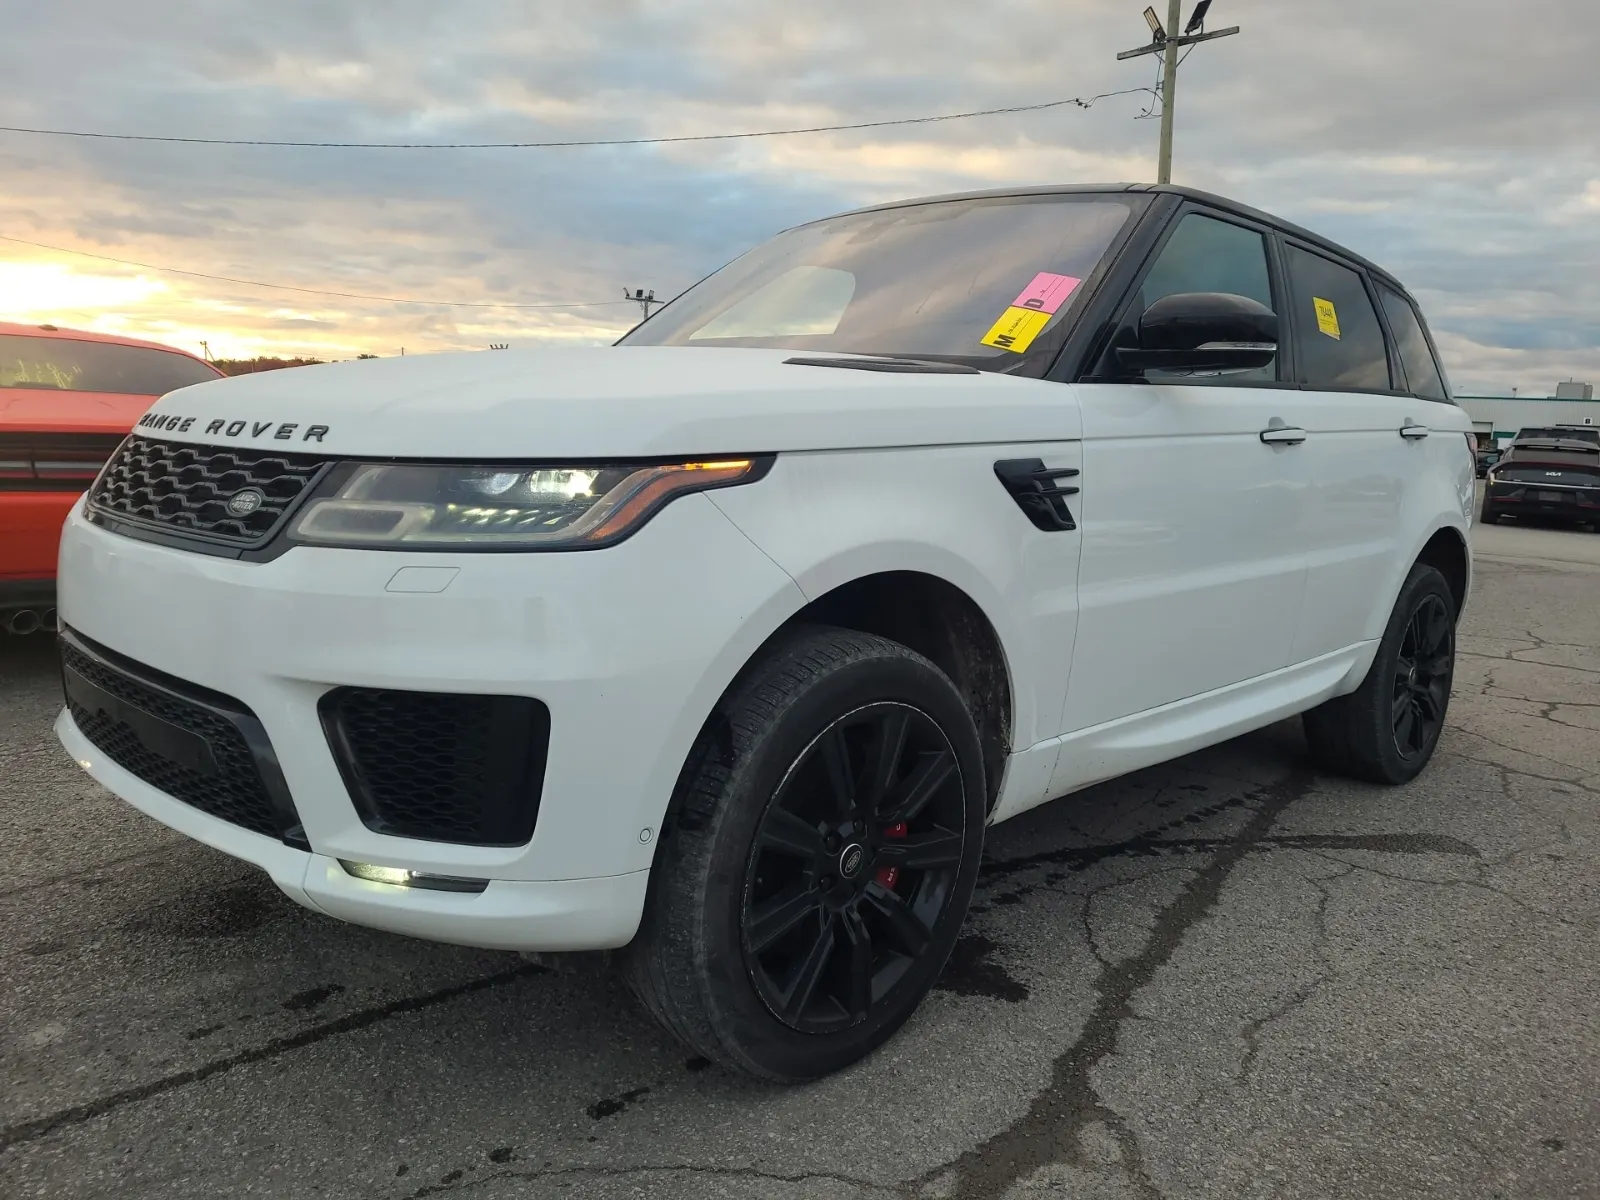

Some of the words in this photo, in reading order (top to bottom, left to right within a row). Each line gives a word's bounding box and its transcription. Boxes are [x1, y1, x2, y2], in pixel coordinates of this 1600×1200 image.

[1023, 298, 1045, 309] D
[993, 334, 1016, 348] M
[138, 413, 197, 433] RANGE
[205, 418, 330, 443] ROVER
